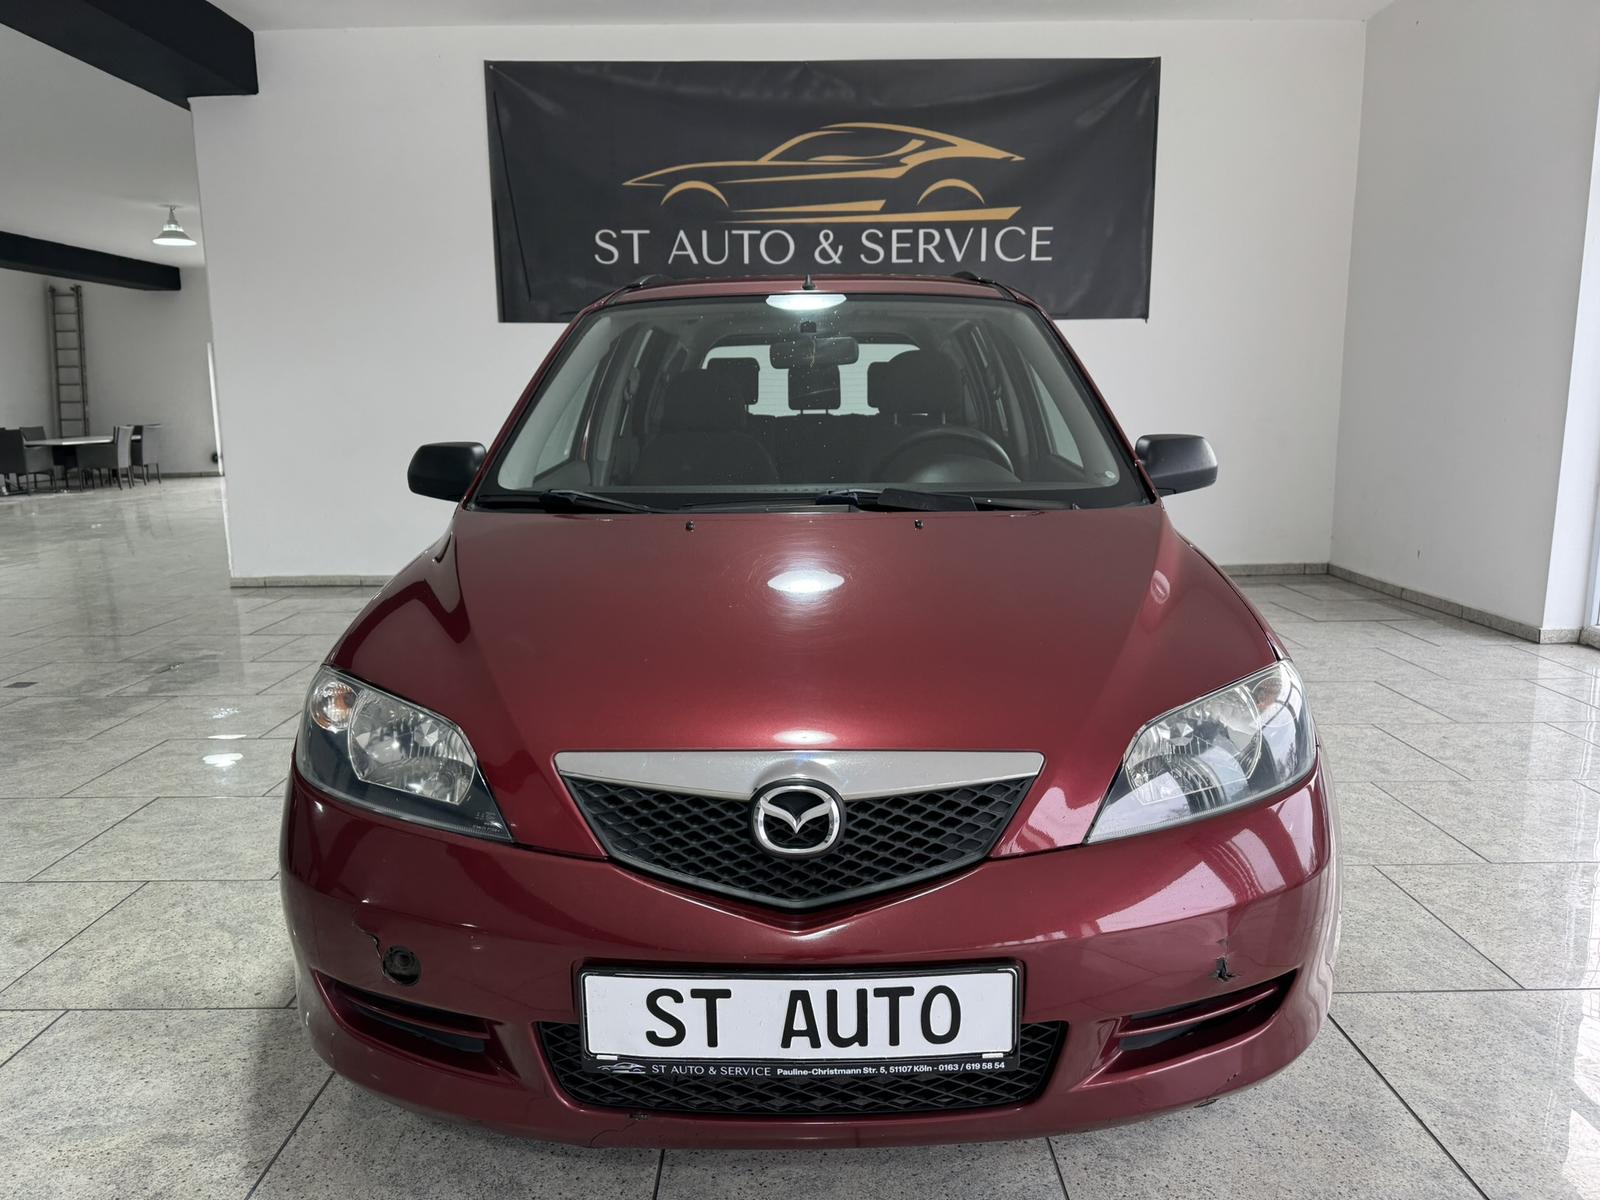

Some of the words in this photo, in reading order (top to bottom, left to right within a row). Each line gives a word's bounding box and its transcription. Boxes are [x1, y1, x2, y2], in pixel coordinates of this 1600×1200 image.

[594, 229, 650, 265] ST
[668, 229, 795, 265] AUTO
[814, 229, 843, 265] &
[860, 226, 1054, 265] SERVICE
[645, 988, 732, 1048] ST
[781, 985, 962, 1049] AUTO
[651, 1064, 667, 1074] ST
[670, 1065, 705, 1075] AUTO
[708, 1066, 717, 1075] &
[720, 1066, 771, 1077] SERVICE
[776, 1067, 862, 1076] Pauline-Christmann
[862, 1066, 878, 1075] Str.
[879, 1066, 888, 1075] 5,
[889, 1065, 913, 1074] 51107
[913, 1064, 932, 1073] Köln
[938, 1063, 959, 1072] 0163
[959, 1063, 965, 1072] /
[965, 1062, 981, 1071] 619
[981, 1062, 993, 1070] 58
[993, 1061, 1005, 1070] 54
